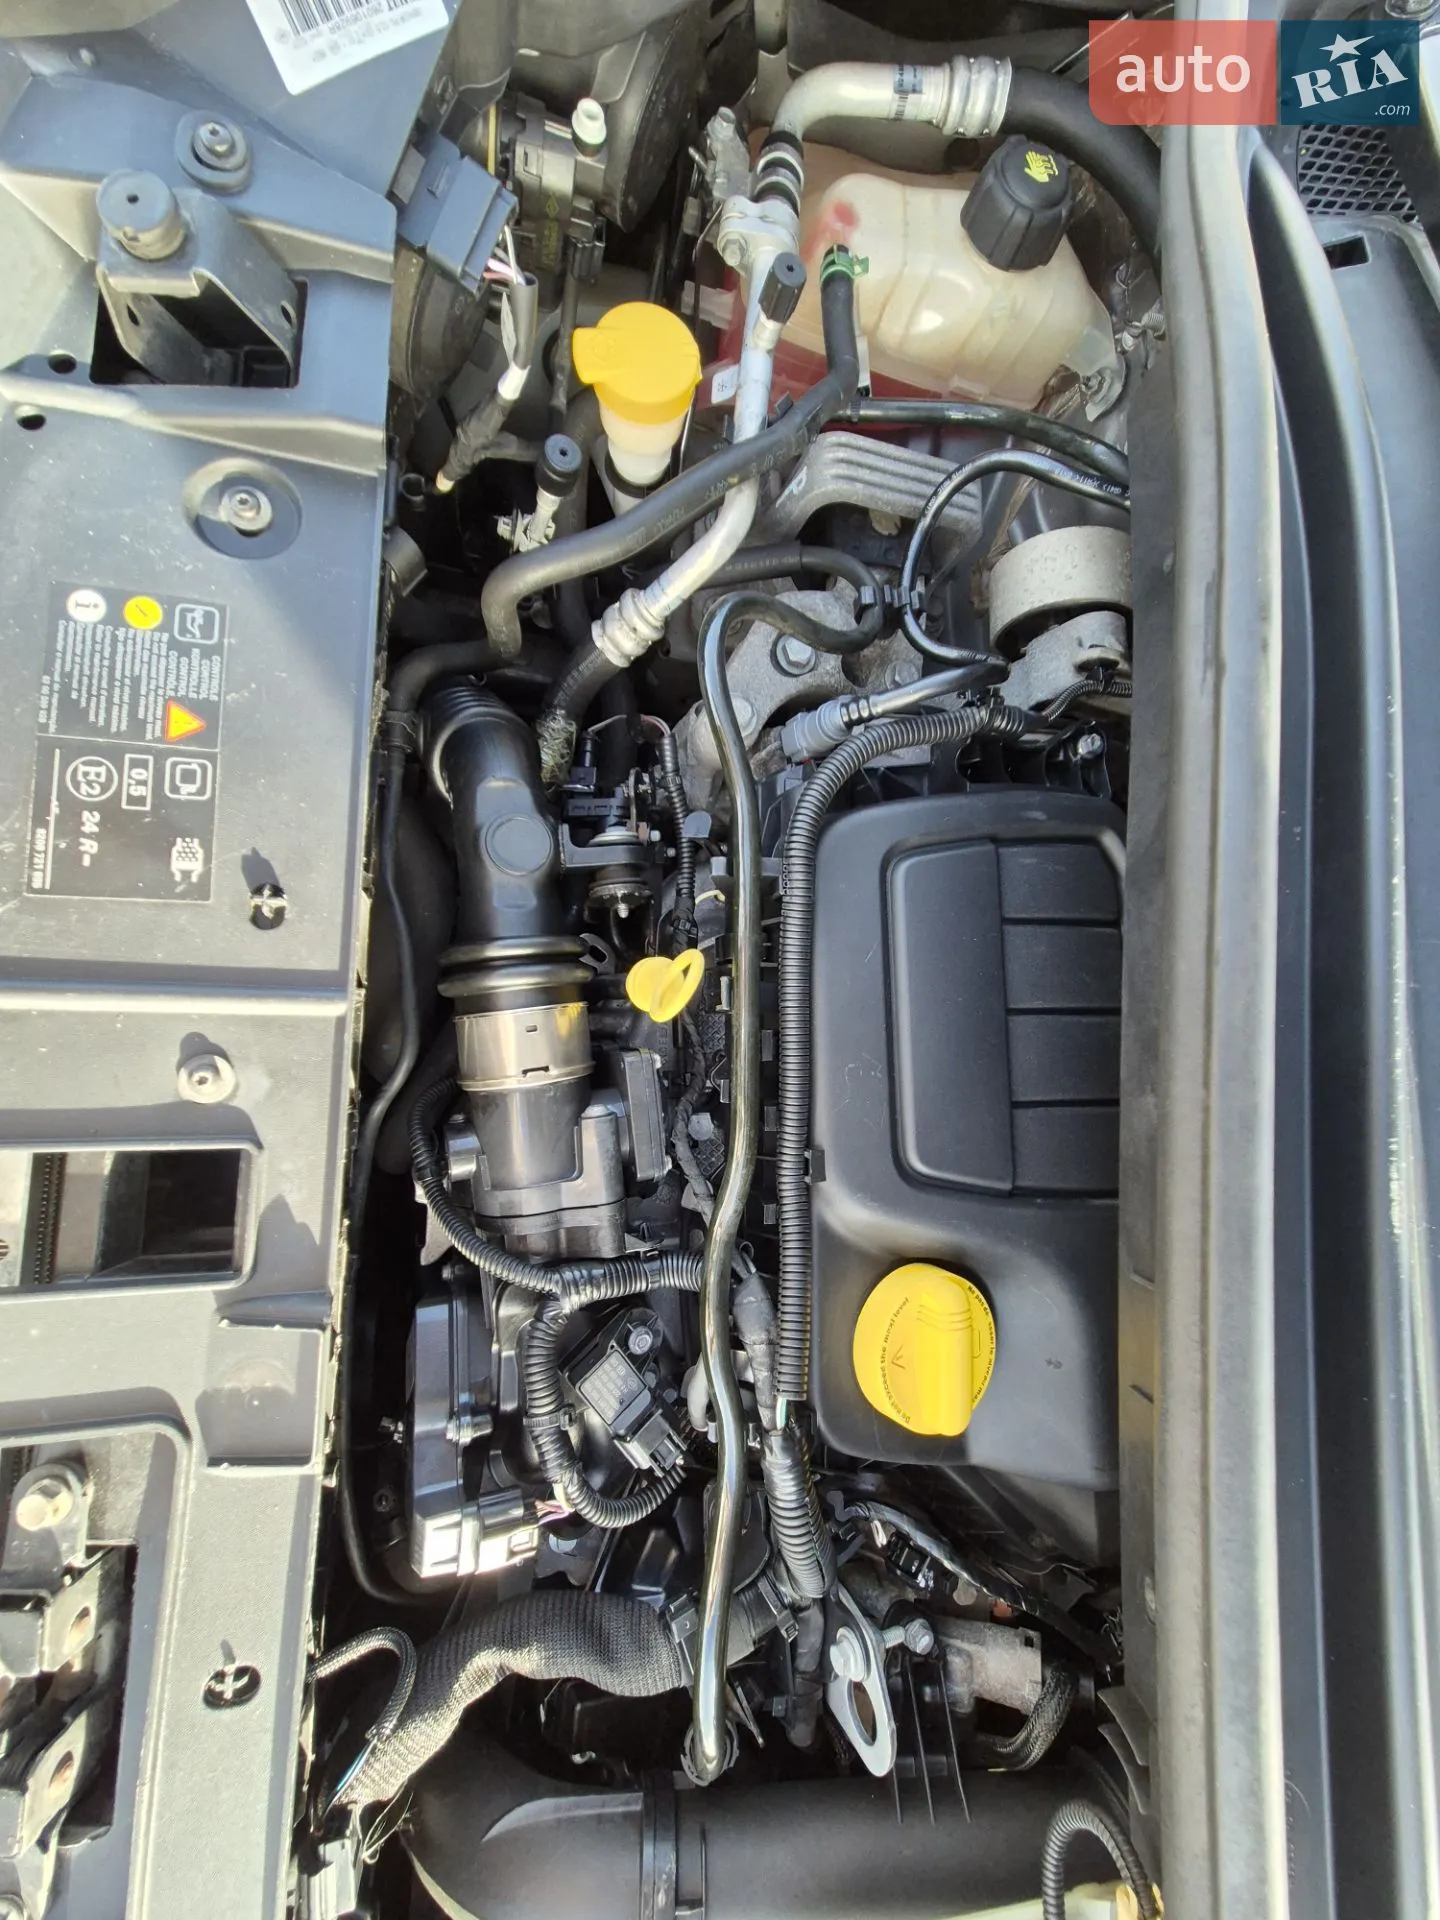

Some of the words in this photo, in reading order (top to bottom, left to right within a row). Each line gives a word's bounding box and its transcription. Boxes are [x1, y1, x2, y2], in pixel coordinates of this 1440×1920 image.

[76, 763, 106, 796] E2
[128, 768, 148, 797] 0,5
[80, 810, 100, 834] 24
[879, 1366, 894, 1401] exceed
[894, 1296, 910, 1318] level
